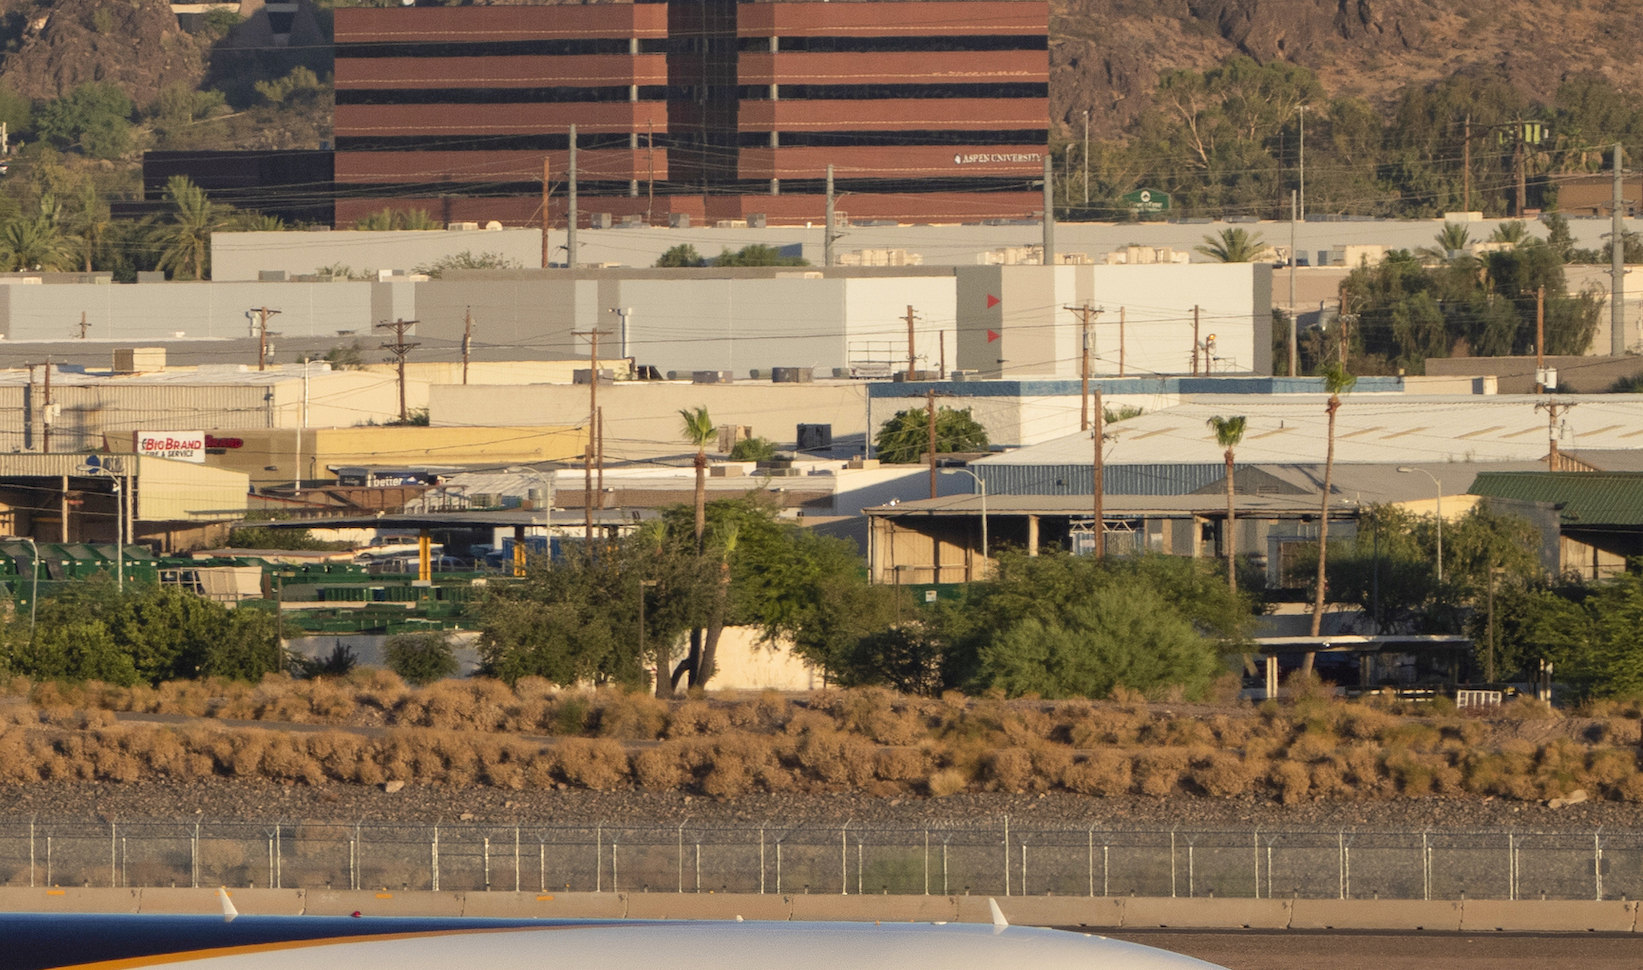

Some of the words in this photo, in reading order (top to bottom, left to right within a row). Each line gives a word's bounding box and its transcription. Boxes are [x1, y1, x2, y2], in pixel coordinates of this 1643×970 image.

[962, 153, 990, 164] ASPEN
[991, 152, 1042, 163] UNIVERSITY
[168, 450, 194, 458] SERVICE
